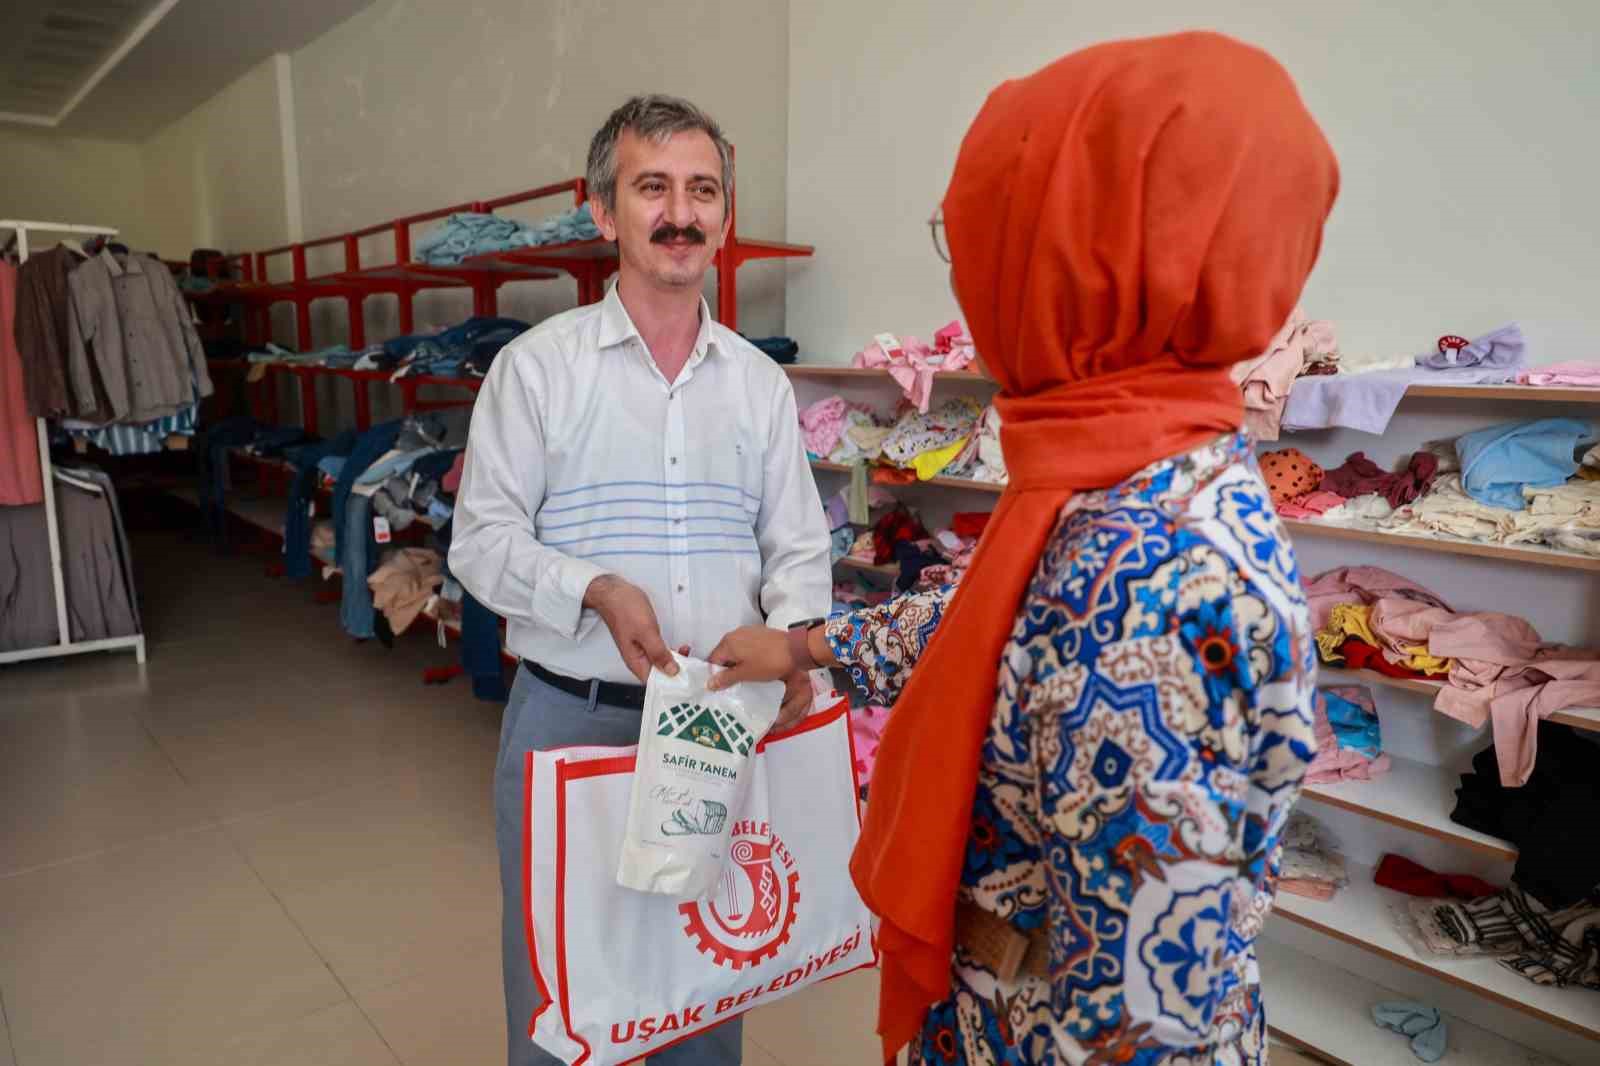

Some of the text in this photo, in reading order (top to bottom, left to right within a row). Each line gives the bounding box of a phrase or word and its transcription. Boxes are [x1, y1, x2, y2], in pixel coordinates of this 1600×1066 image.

[662, 753, 697, 769] SAFİR
[700, 761, 737, 780] TANEM
[610, 924, 861, 1044] UŞAK BELEDİYESİ
